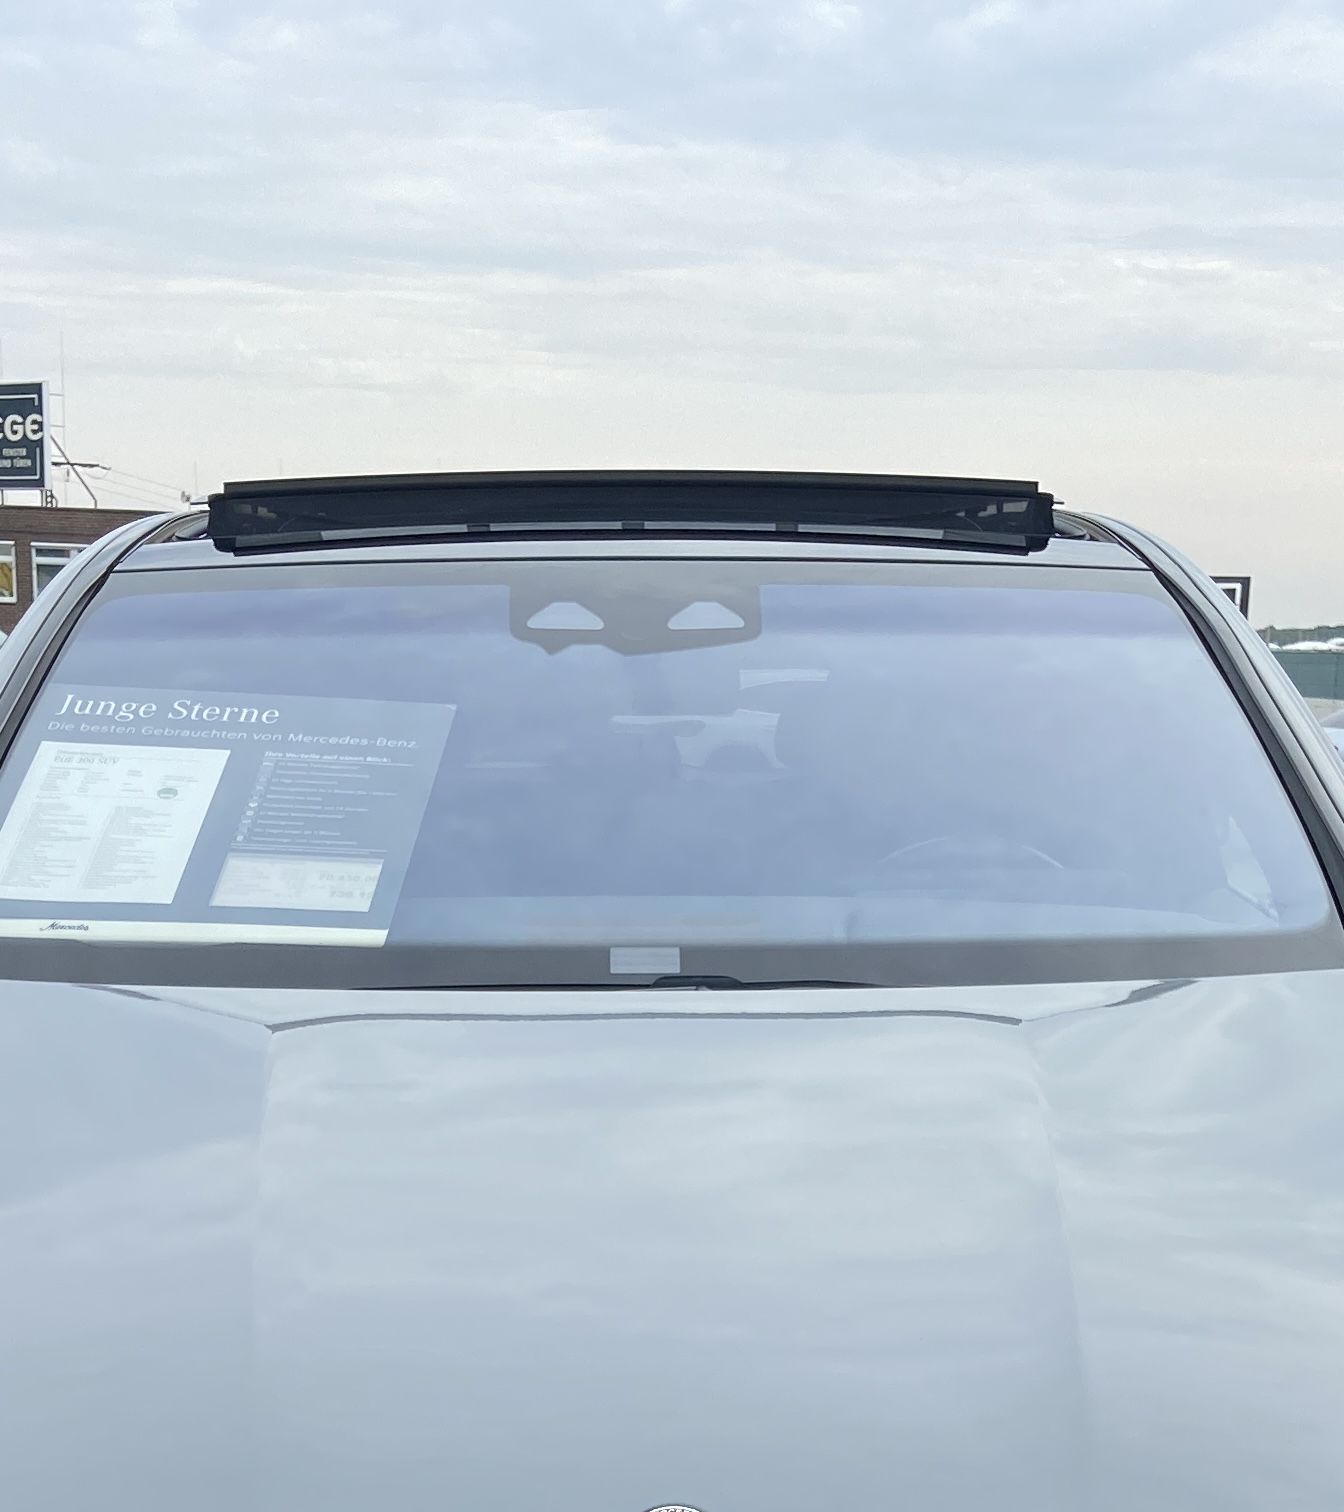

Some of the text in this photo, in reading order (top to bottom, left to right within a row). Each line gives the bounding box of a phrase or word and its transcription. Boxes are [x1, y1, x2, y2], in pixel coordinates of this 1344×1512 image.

[55, 694, 280, 724] Junge Sterne
[47, 721, 75, 731] Die
[80, 722, 136, 734] besten
[141, 726, 247, 740] Gebrauchten
[253, 733, 282, 741] von
